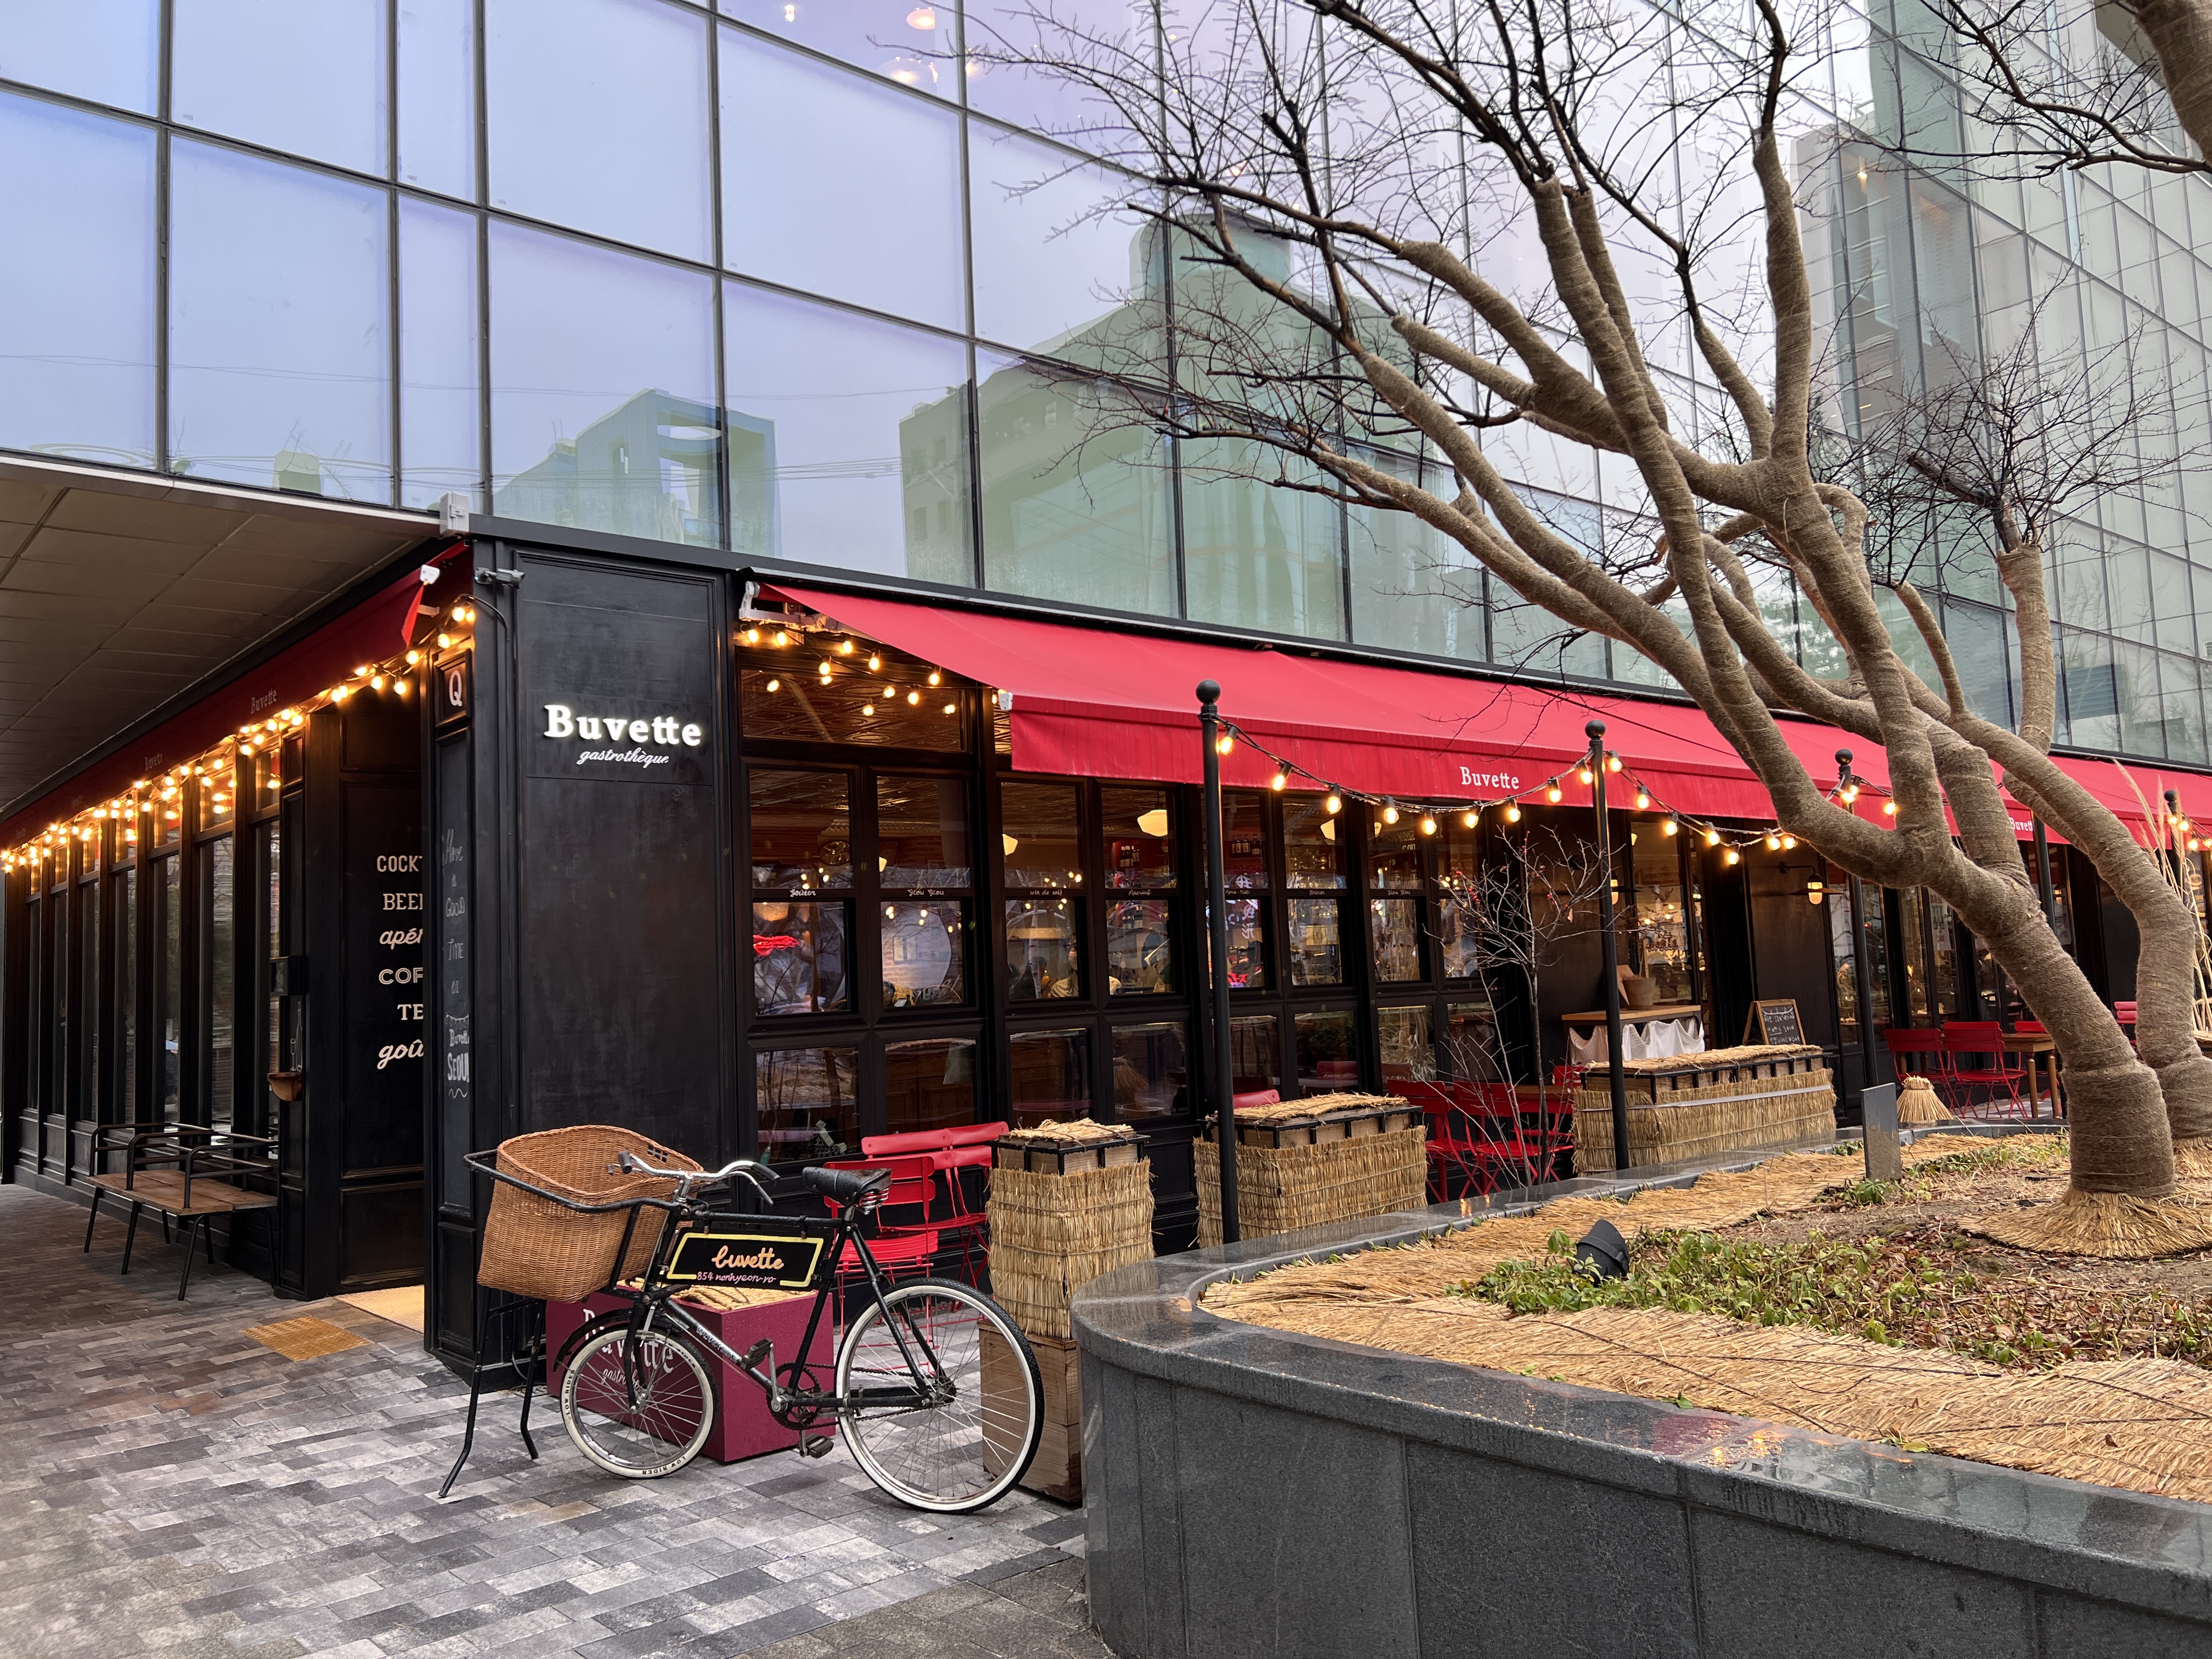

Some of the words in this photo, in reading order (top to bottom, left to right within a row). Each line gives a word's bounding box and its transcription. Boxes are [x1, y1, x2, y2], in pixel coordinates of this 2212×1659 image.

[449, 670, 462, 707] Q
[251, 689, 277, 714] Buvette
[544, 704, 701, 746] Buvette
[576, 747, 669, 769] gastrothèque
[1459, 766, 1519, 789] Buvette
[377, 855, 423, 872] COCK
[712, 1245, 785, 1270] buvette
[697, 1271, 714, 1282] 854
[715, 1273, 777, 1284] nonhyeon-ro
